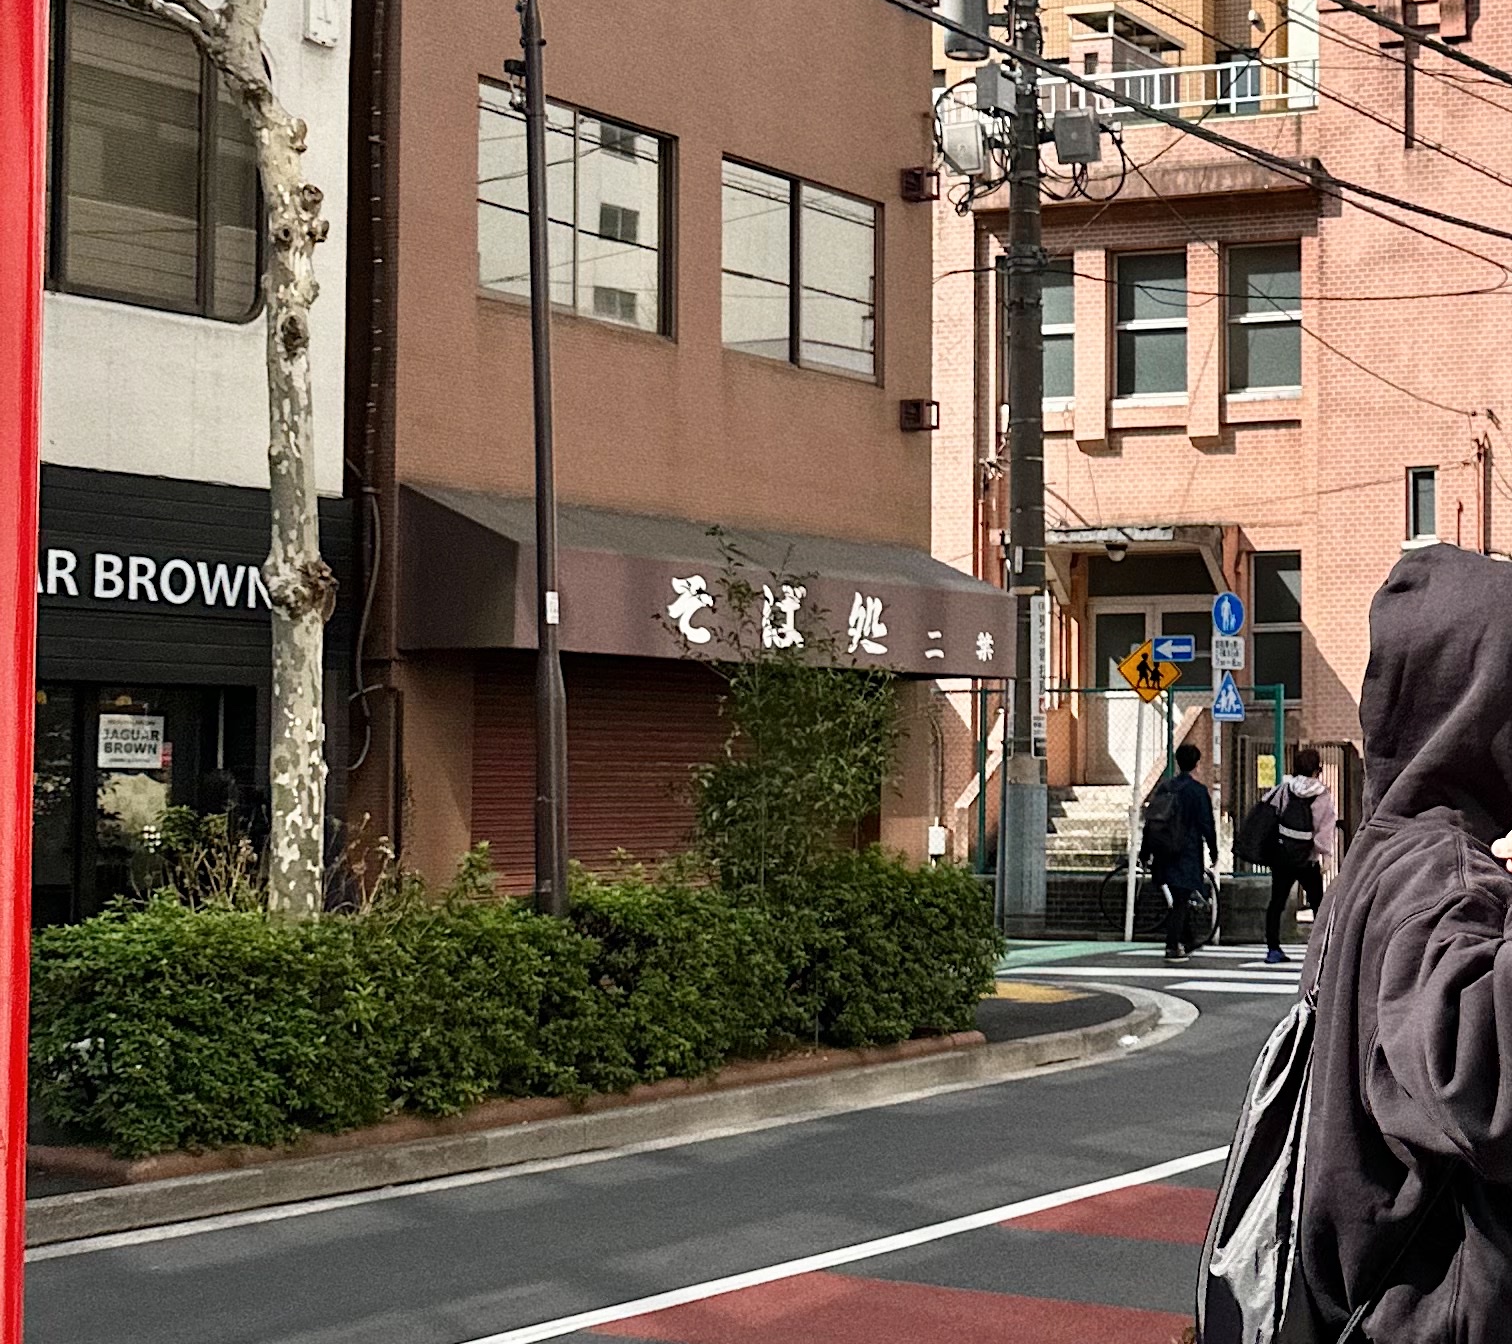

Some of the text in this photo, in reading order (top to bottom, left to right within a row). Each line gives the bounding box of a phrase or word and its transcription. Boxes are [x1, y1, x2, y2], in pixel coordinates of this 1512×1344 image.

[37, 548, 79, 597] R
[667, 575, 888, 655] そば処
[104, 741, 157, 755] BROWN
